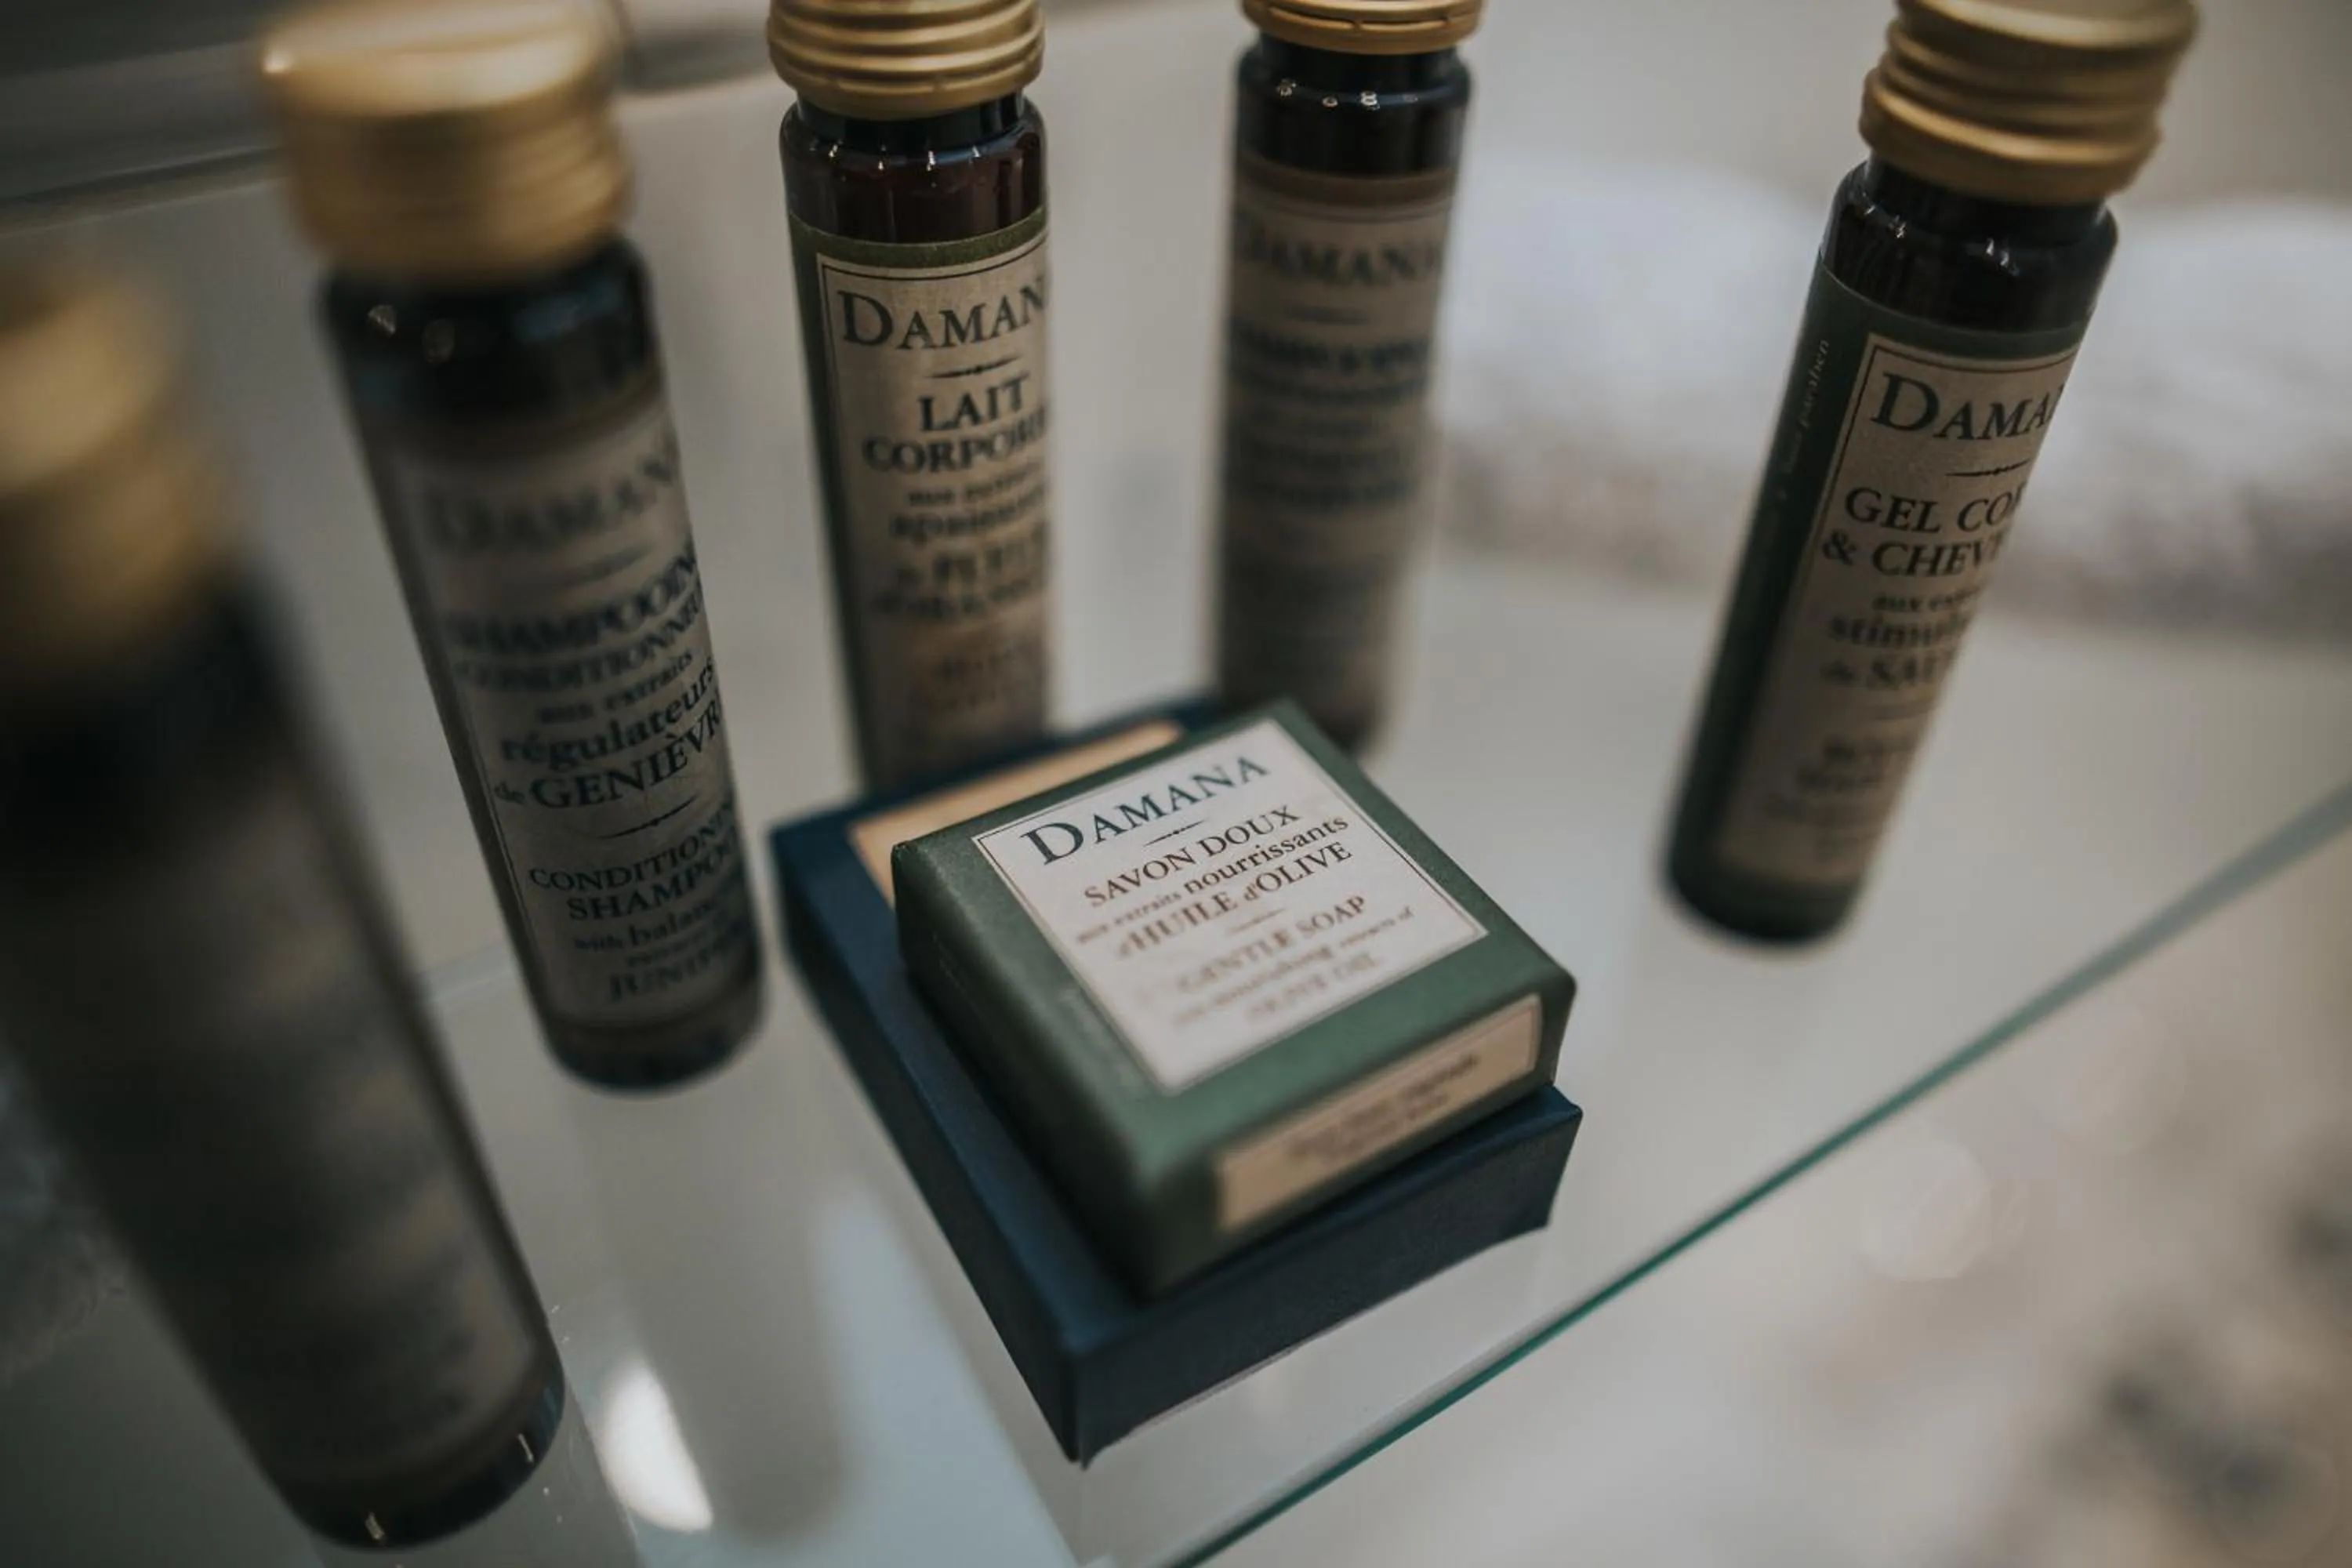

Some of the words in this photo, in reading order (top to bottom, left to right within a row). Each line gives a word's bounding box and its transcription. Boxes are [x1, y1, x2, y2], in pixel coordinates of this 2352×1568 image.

[917, 372, 1029, 432] LAIT
[1871, 372, 2064, 441] DAMA
[1845, 487, 1941, 533] GEL
[1822, 528, 1857, 565] &
[499, 657, 713, 771] régulateurs
[528, 694, 722, 809] GENIÈVR
[1019, 756, 1272, 866] DAMANA
[1084, 847, 1198, 907] SAVON
[1197, 804, 1301, 857] DOUX
[1183, 813, 1349, 895] nourrissants
[1243, 840, 1353, 903] d'OLIVE
[1296, 895, 1367, 938] SOAP
